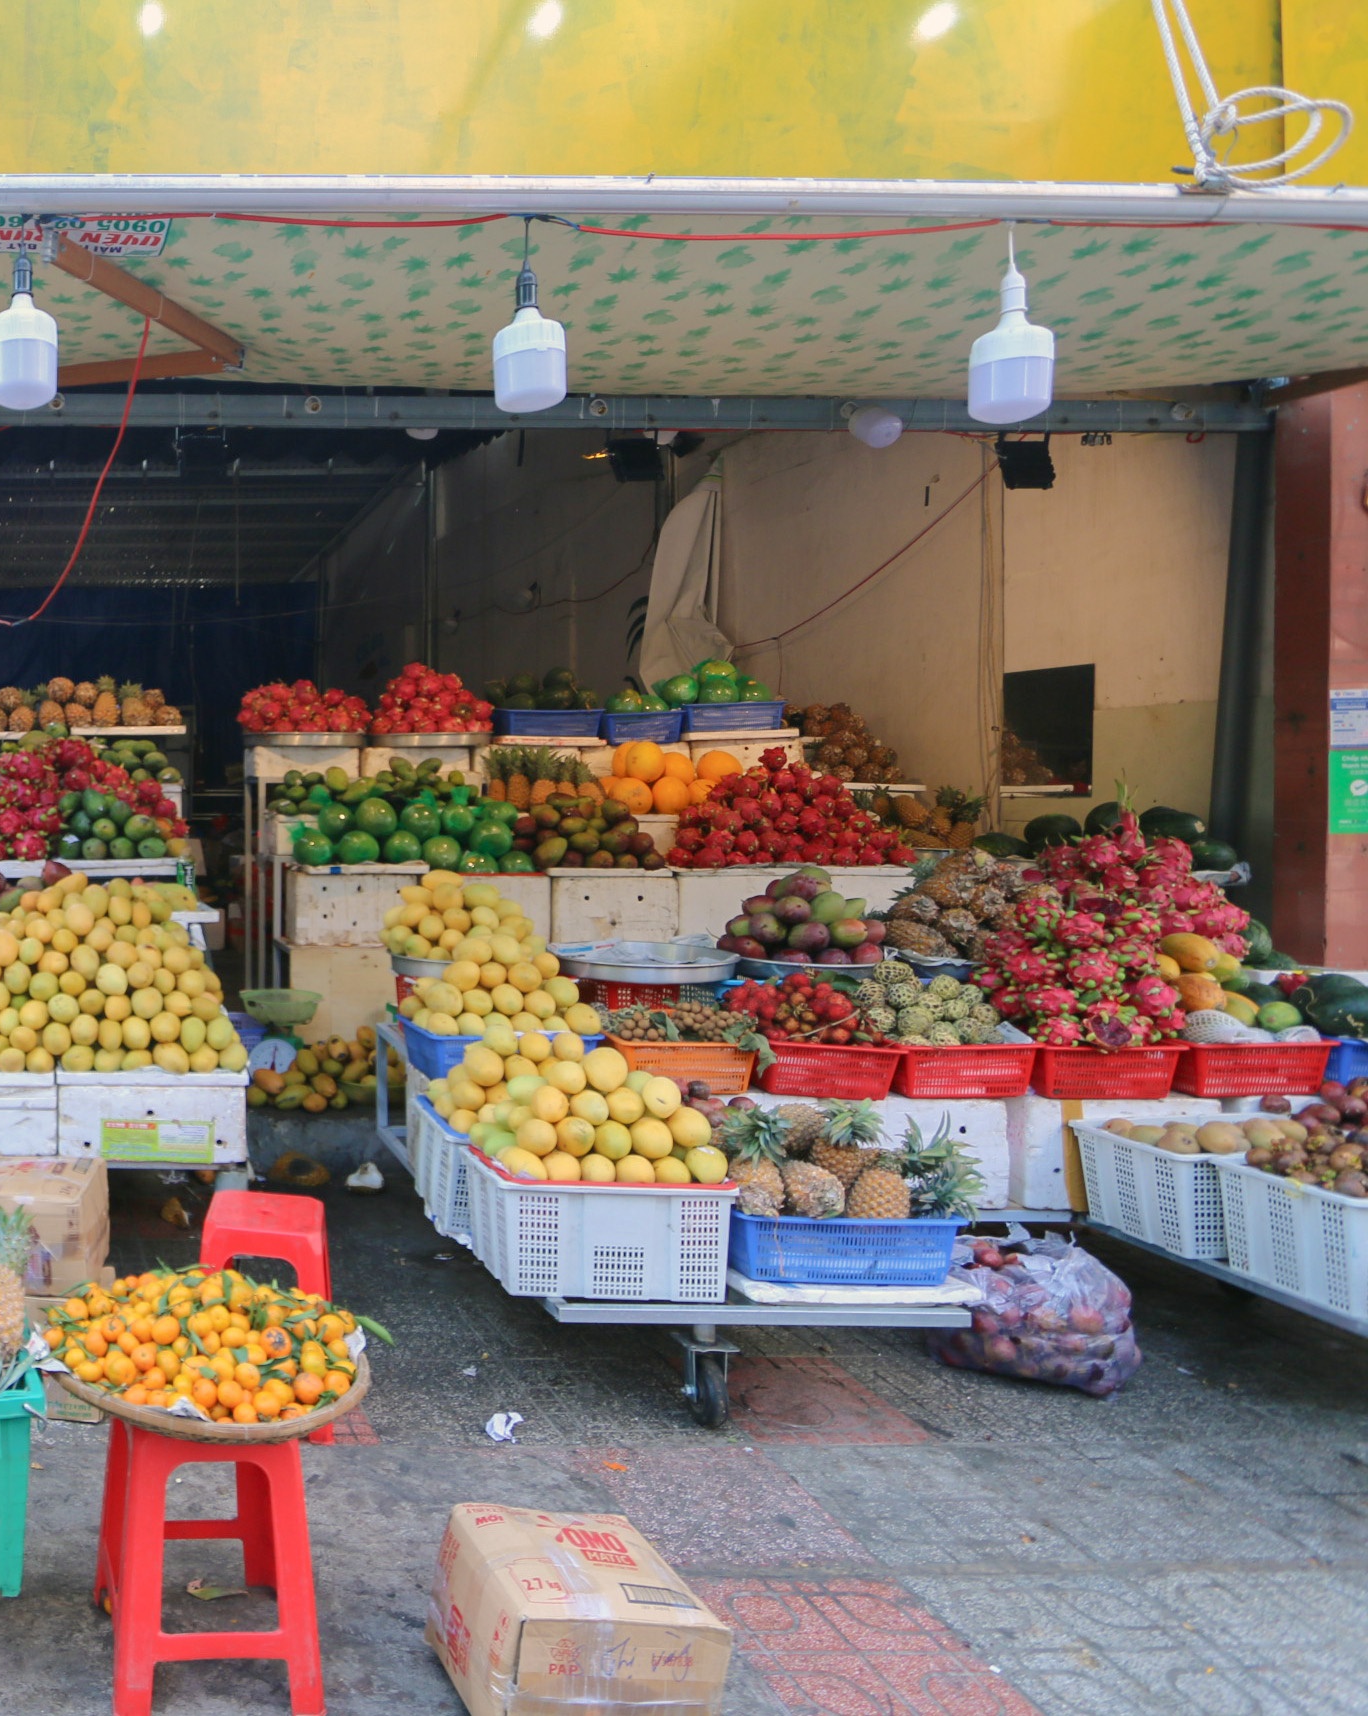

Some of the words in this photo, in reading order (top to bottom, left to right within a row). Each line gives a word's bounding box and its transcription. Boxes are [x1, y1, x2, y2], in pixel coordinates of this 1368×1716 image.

[561, 1527, 628, 1554] OMO
[586, 1551, 631, 1565] MATIC
[521, 1577, 544, 1591] 2.7
[549, 1663, 580, 1676] PAP
